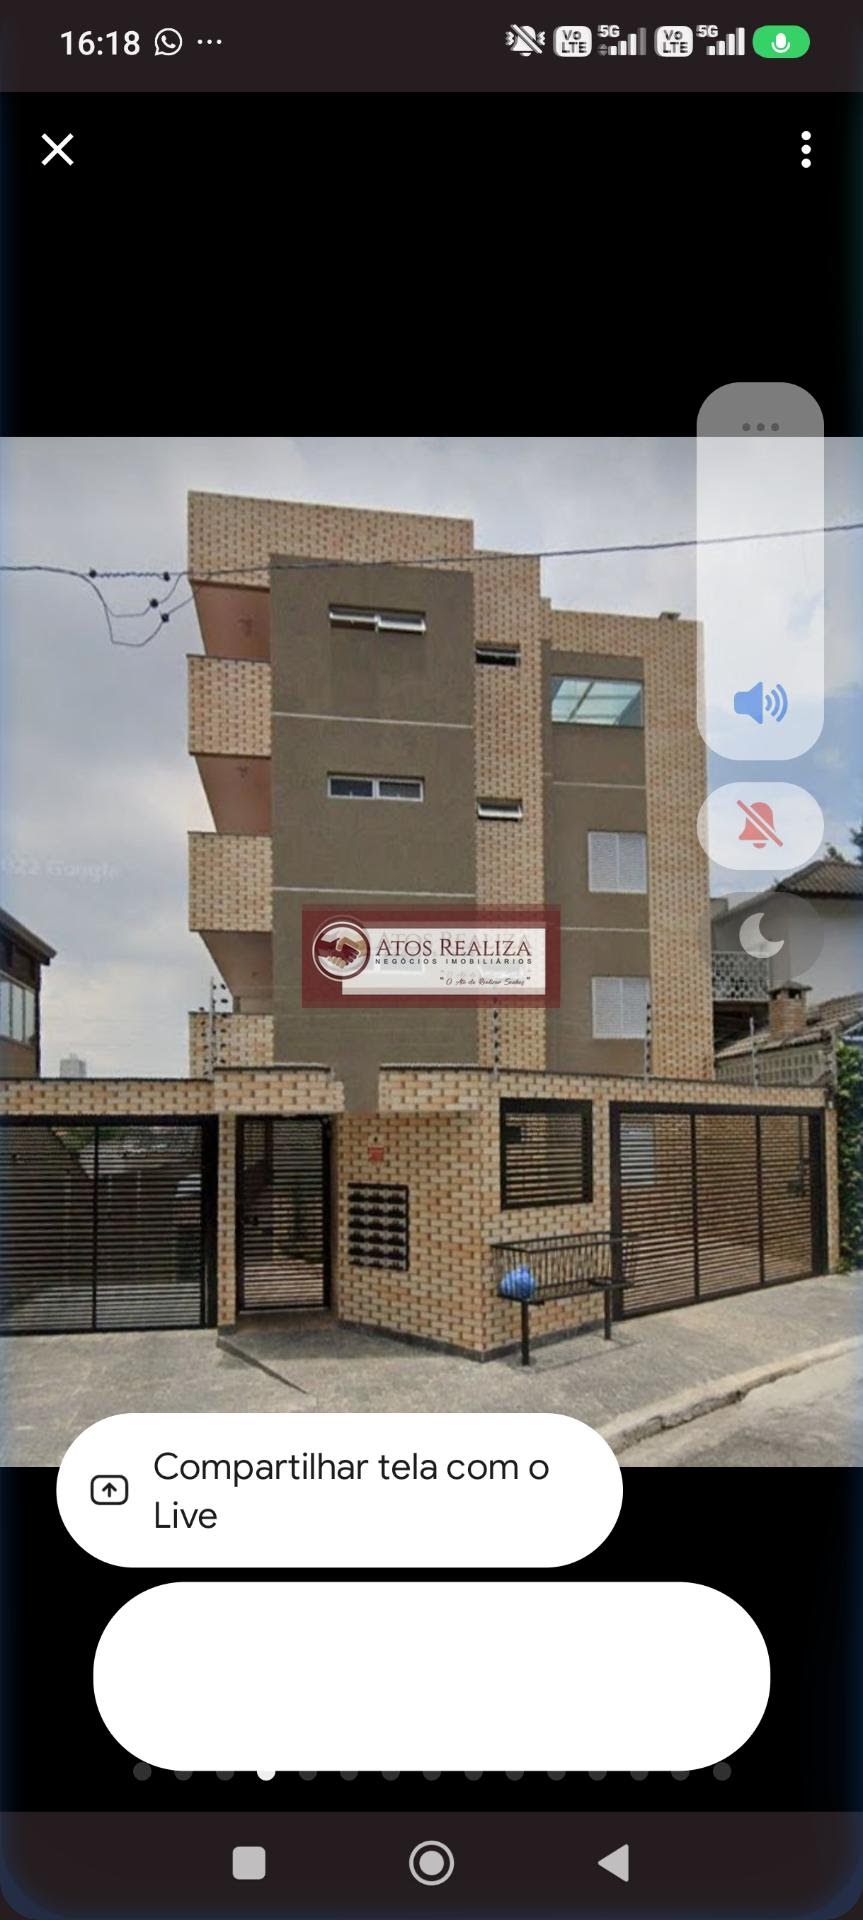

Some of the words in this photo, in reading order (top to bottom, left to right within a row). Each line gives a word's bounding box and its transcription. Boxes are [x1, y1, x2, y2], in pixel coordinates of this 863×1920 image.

[561, 29, 582, 41] Vo
[597, 24, 621, 38] 5G
[662, 29, 683, 41] Vo
[695, 24, 719, 38] 5G
[60, 30, 141, 56] 16:18
[561, 41, 588, 54] LTE
[662, 41, 689, 54] LTE
[153, 1451, 369, 1487] Compartilhar
[377, 1452, 438, 1481] tela
[446, 1458, 520, 1481] com
[528, 1458, 550, 1481] o
[153, 1500, 218, 1530] Live
